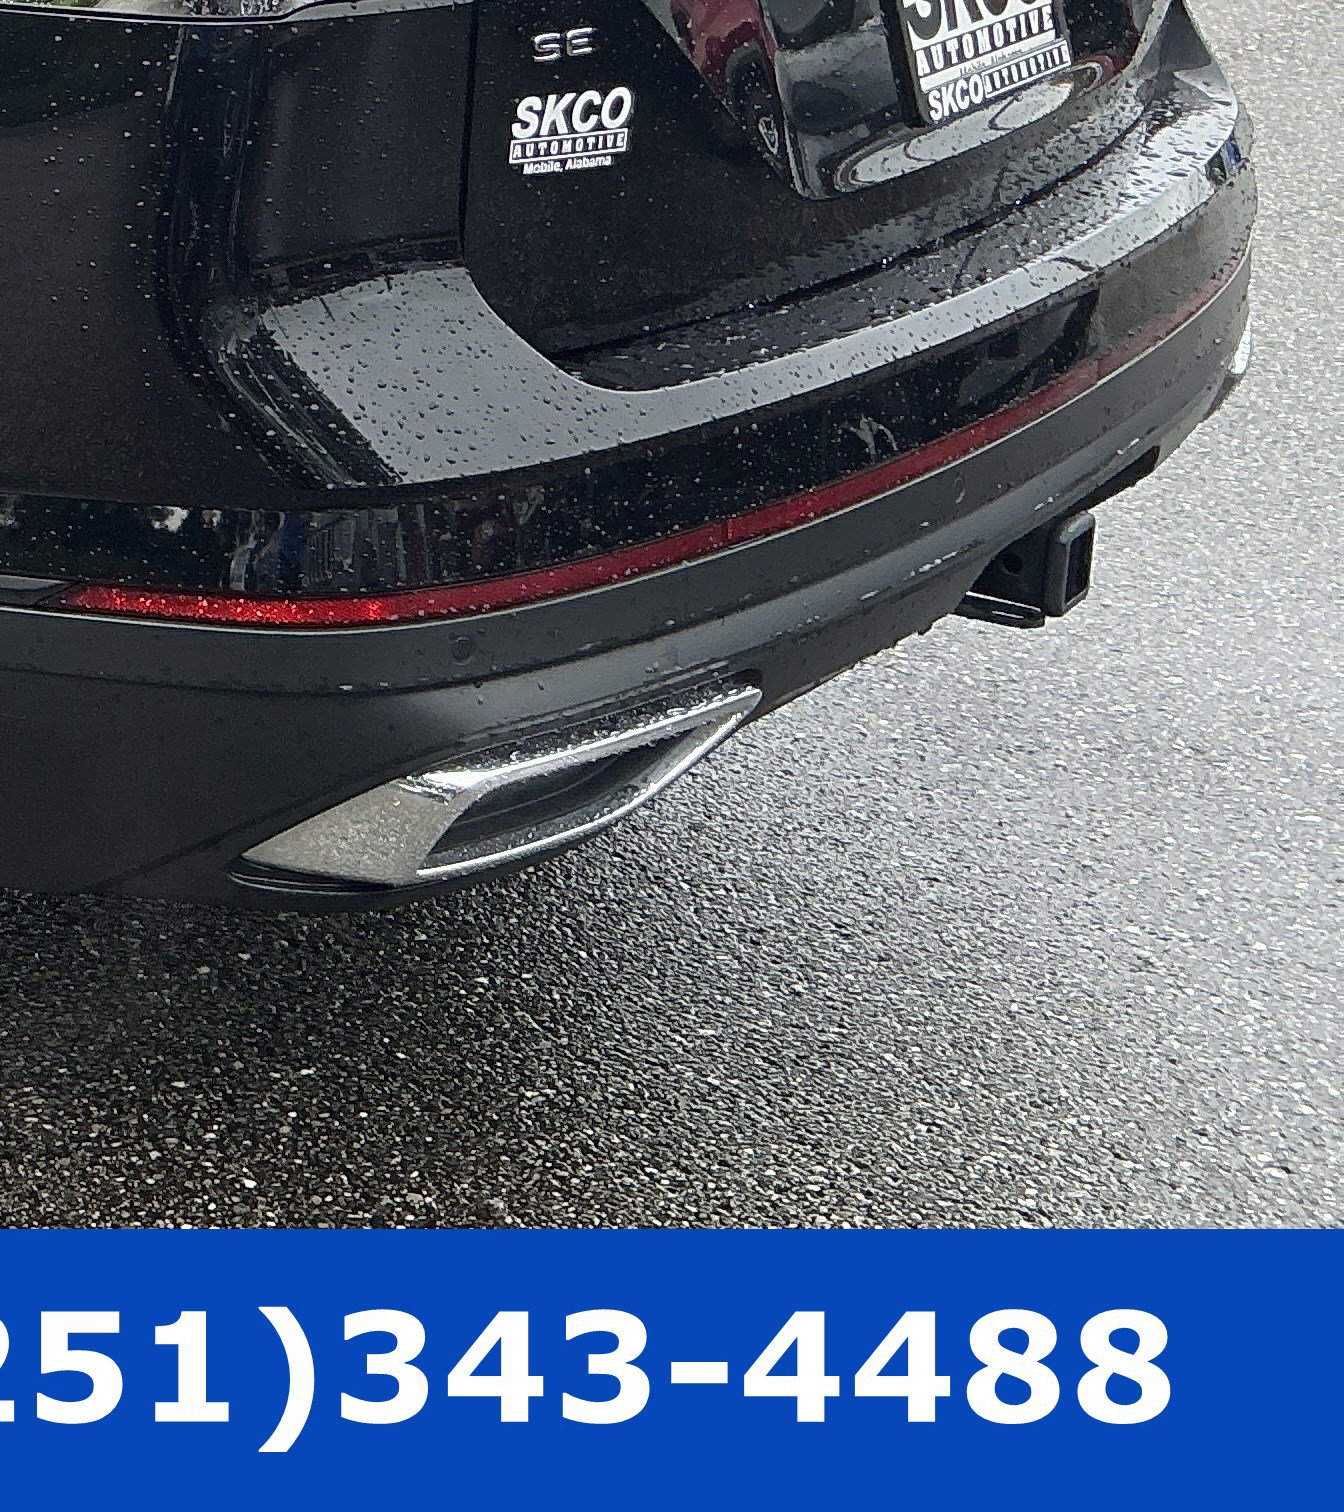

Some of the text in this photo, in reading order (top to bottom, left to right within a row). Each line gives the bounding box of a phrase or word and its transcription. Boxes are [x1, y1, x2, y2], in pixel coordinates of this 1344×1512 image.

[532, 27, 598, 63] SE
[915, 4, 1054, 77] AUTOMOTIVE
[511, 86, 633, 139] SKCO
[928, 73, 984, 121] SKCO
[512, 132, 626, 159] AUTOMOTIVE
[565, 155, 613, 171] Alabama
